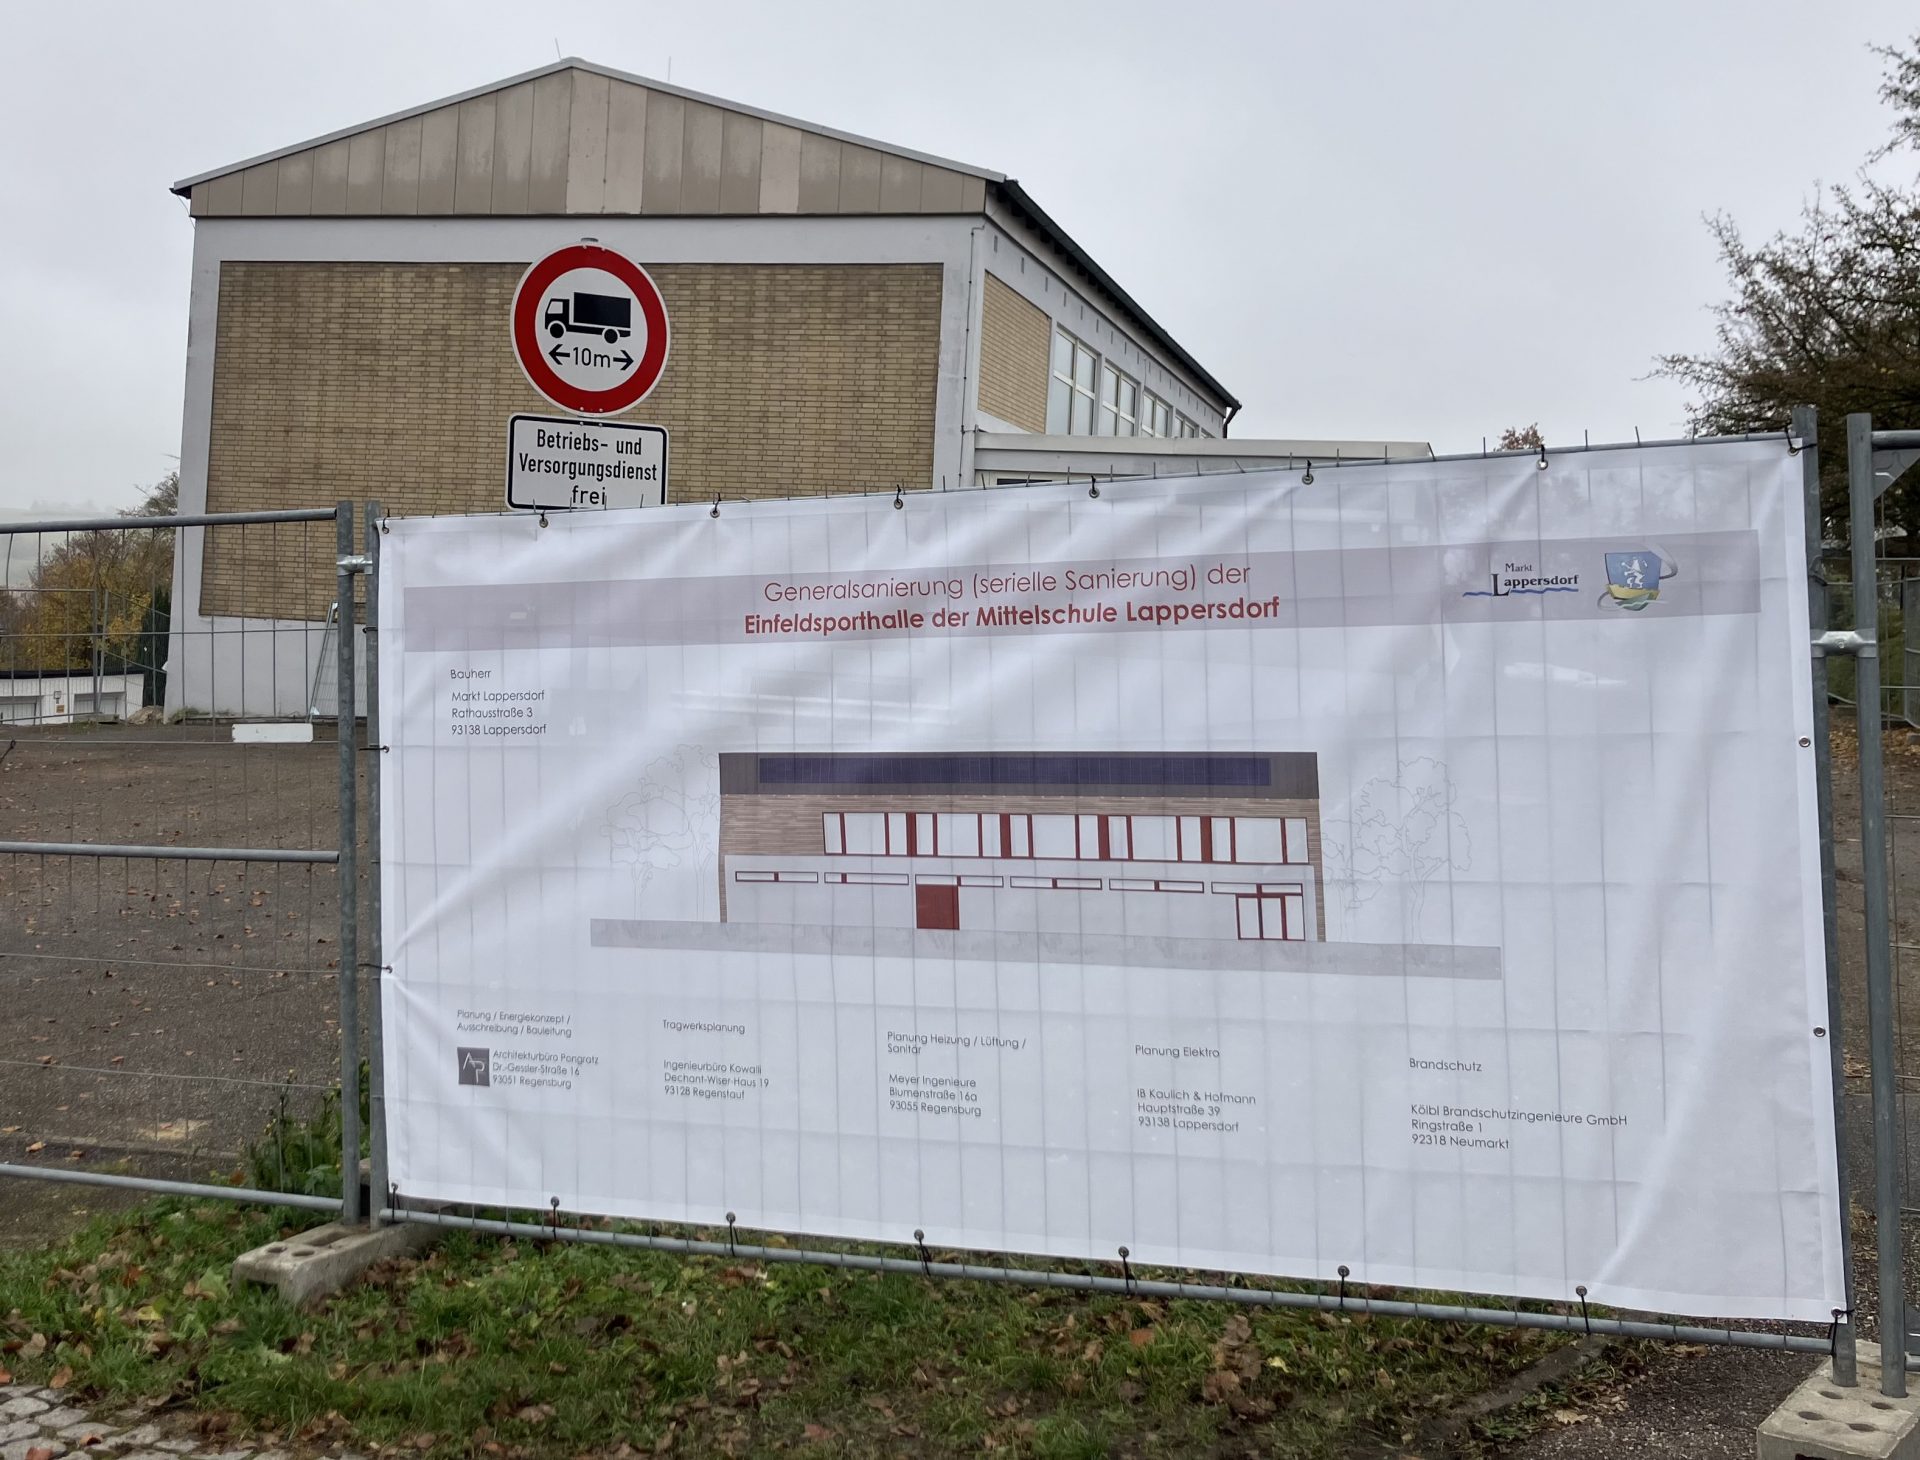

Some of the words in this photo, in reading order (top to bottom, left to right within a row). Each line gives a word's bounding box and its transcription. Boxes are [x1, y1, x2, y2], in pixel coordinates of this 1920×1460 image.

[573, 346, 611, 368] 10m
[537, 429, 608, 452] Betriebs-
[616, 437, 642, 455] und
[519, 453, 657, 482] Versorgungsdienst
[572, 486, 606, 505] frei
[1505, 563, 1532, 572] Markt
[764, 578, 963, 601] Generalsanierung
[972, 571, 1057, 599] (serielle
[1065, 565, 1196, 594] Sanierung)
[1207, 564, 1251, 585] der
[1492, 573, 1579, 596] Lappersdorf
[744, 610, 924, 635] Einfeldsporthalle
[932, 609, 969, 628] der
[976, 601, 1117, 627] Mittelschule
[1127, 596, 1279, 623] Lappersdorf
[451, 669, 491, 679] Bauherr
[452, 691, 480, 701] Markt
[484, 690, 544, 702] Lappersdorf
[452, 707, 523, 718] Rathausstraße
[527, 707, 533, 717] 3
[451, 725, 480, 735] 93138
[484, 724, 547, 736] Lappersdorf
[457, 1010, 491, 1021] Planung
[500, 1012, 564, 1024] Energiekonzept
[457, 1023, 518, 1035] Ausschreibung
[527, 1026, 571, 1038] Bauleitung
[663, 1020, 745, 1034] Tragwerksplanung
[888, 1032, 927, 1044] Planung
[931, 1034, 970, 1046] Heizung
[974, 1036, 977, 1046] /
[981, 1037, 1018, 1049] Lüftung
[1022, 1038, 1026, 1048] /
[888, 1044, 921, 1054] Sanitär
[1135, 1045, 1180, 1058] Planung
[1184, 1046, 1220, 1057] Elektro
[493, 1050, 558, 1062] Architekturbüro
[561, 1054, 599, 1065] Pangratz
[571, 1067, 580, 1075] 16
[664, 1060, 727, 1073] Ingenieurbüro
[1409, 1058, 1482, 1072] Brandschutz
[493, 1075, 516, 1084] 93051
[520, 1078, 571, 1089] Regensburg
[760, 1078, 769, 1088] 19
[889, 1074, 920, 1085] Meyer
[922, 1076, 976, 1087] Ingenieure
[665, 1085, 690, 1096] 93128
[693, 1087, 744, 1099] Regenstauf
[890, 1087, 955, 1100] Blumenstraße
[959, 1091, 977, 1101] 16a
[1137, 1088, 1146, 1098] IB
[1150, 1089, 1189, 1100] Kaulich
[1194, 1091, 1201, 1101] &
[890, 1101, 918, 1111] 93055
[921, 1102, 981, 1117] Regensburg
[1138, 1103, 1204, 1115] Hauptstraße
[1208, 1106, 1220, 1116] 39
[1411, 1105, 1440, 1116] Kölbl
[1443, 1105, 1582, 1124] Brandschutzingenieure
[1586, 1114, 1627, 1126] GmbH
[1139, 1116, 1169, 1127] 93138
[1174, 1118, 1239, 1132] Lappersdorf
[1412, 1119, 1474, 1133] Ringstraße
[1478, 1122, 1482, 1132] 1
[1412, 1134, 1446, 1146] 92318
[1450, 1136, 1509, 1149] Neumarkt
